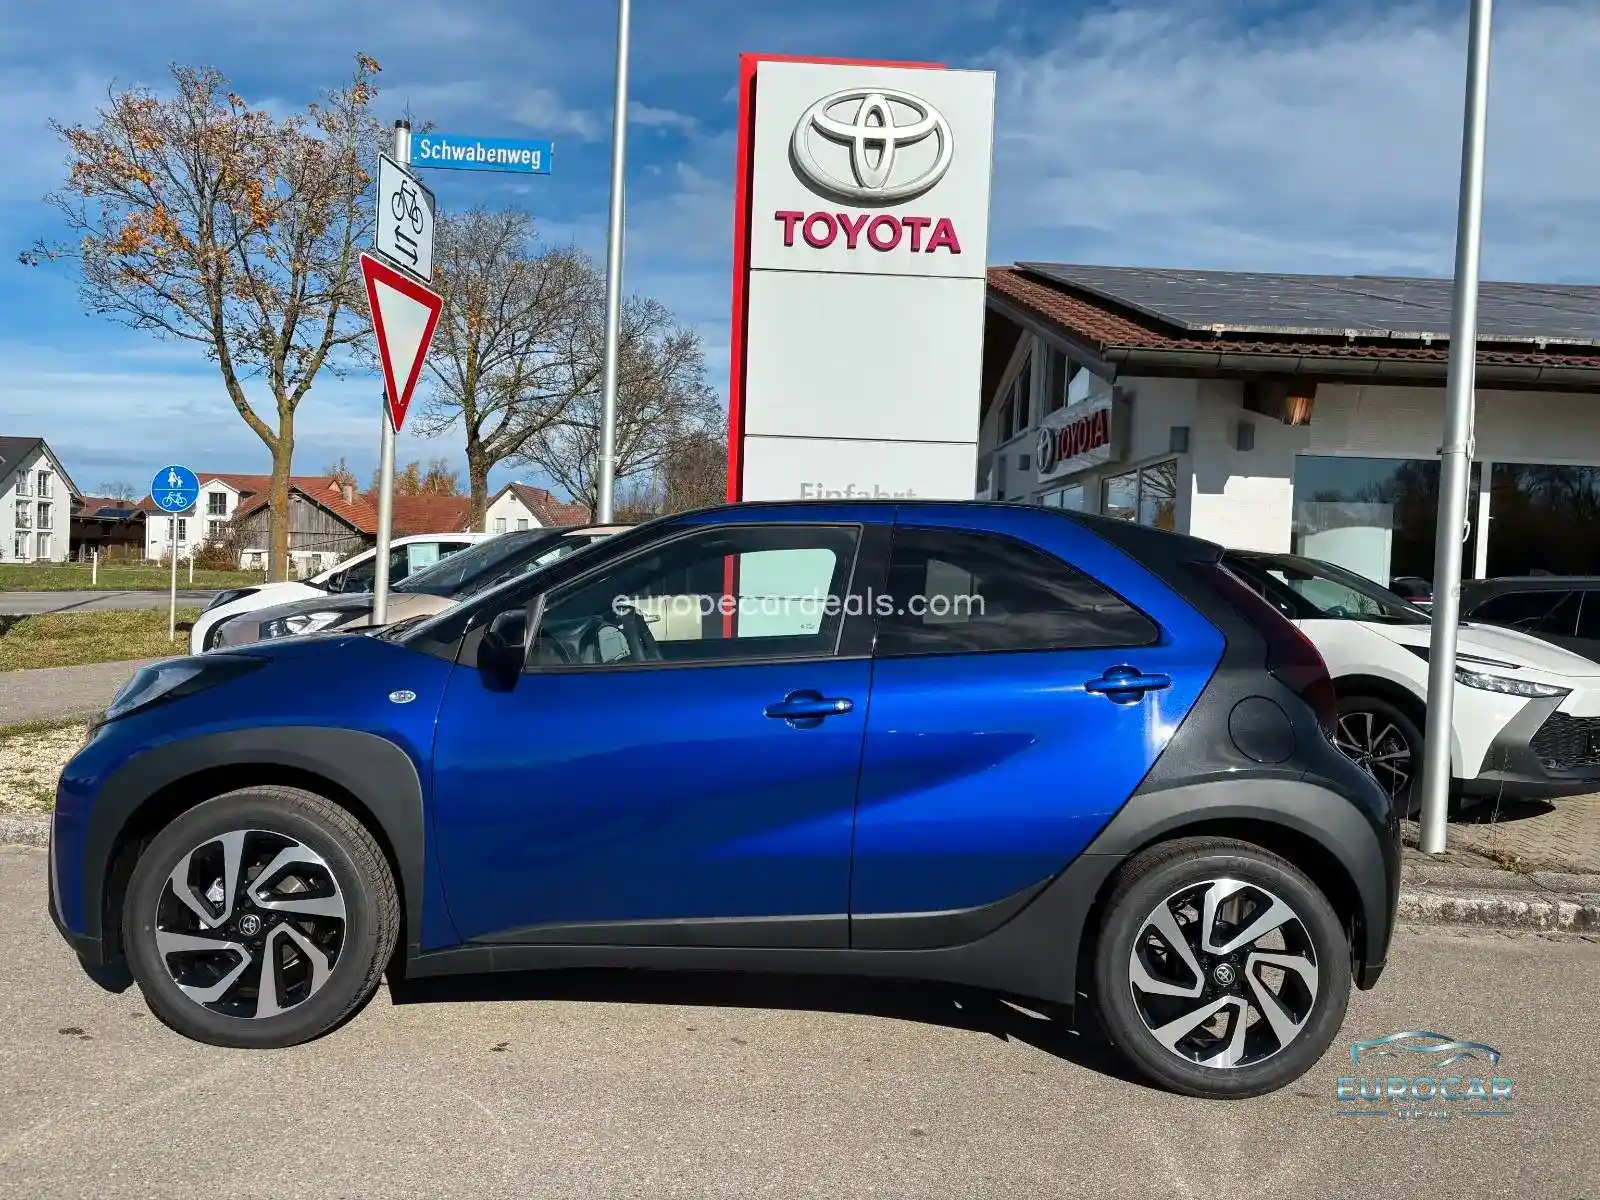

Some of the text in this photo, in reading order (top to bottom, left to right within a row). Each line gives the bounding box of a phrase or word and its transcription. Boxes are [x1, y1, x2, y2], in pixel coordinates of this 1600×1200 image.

[420, 139, 541, 169] Schwabenweg
[774, 210, 962, 254] TOYOTA
[1055, 409, 1109, 461] TOYOTA
